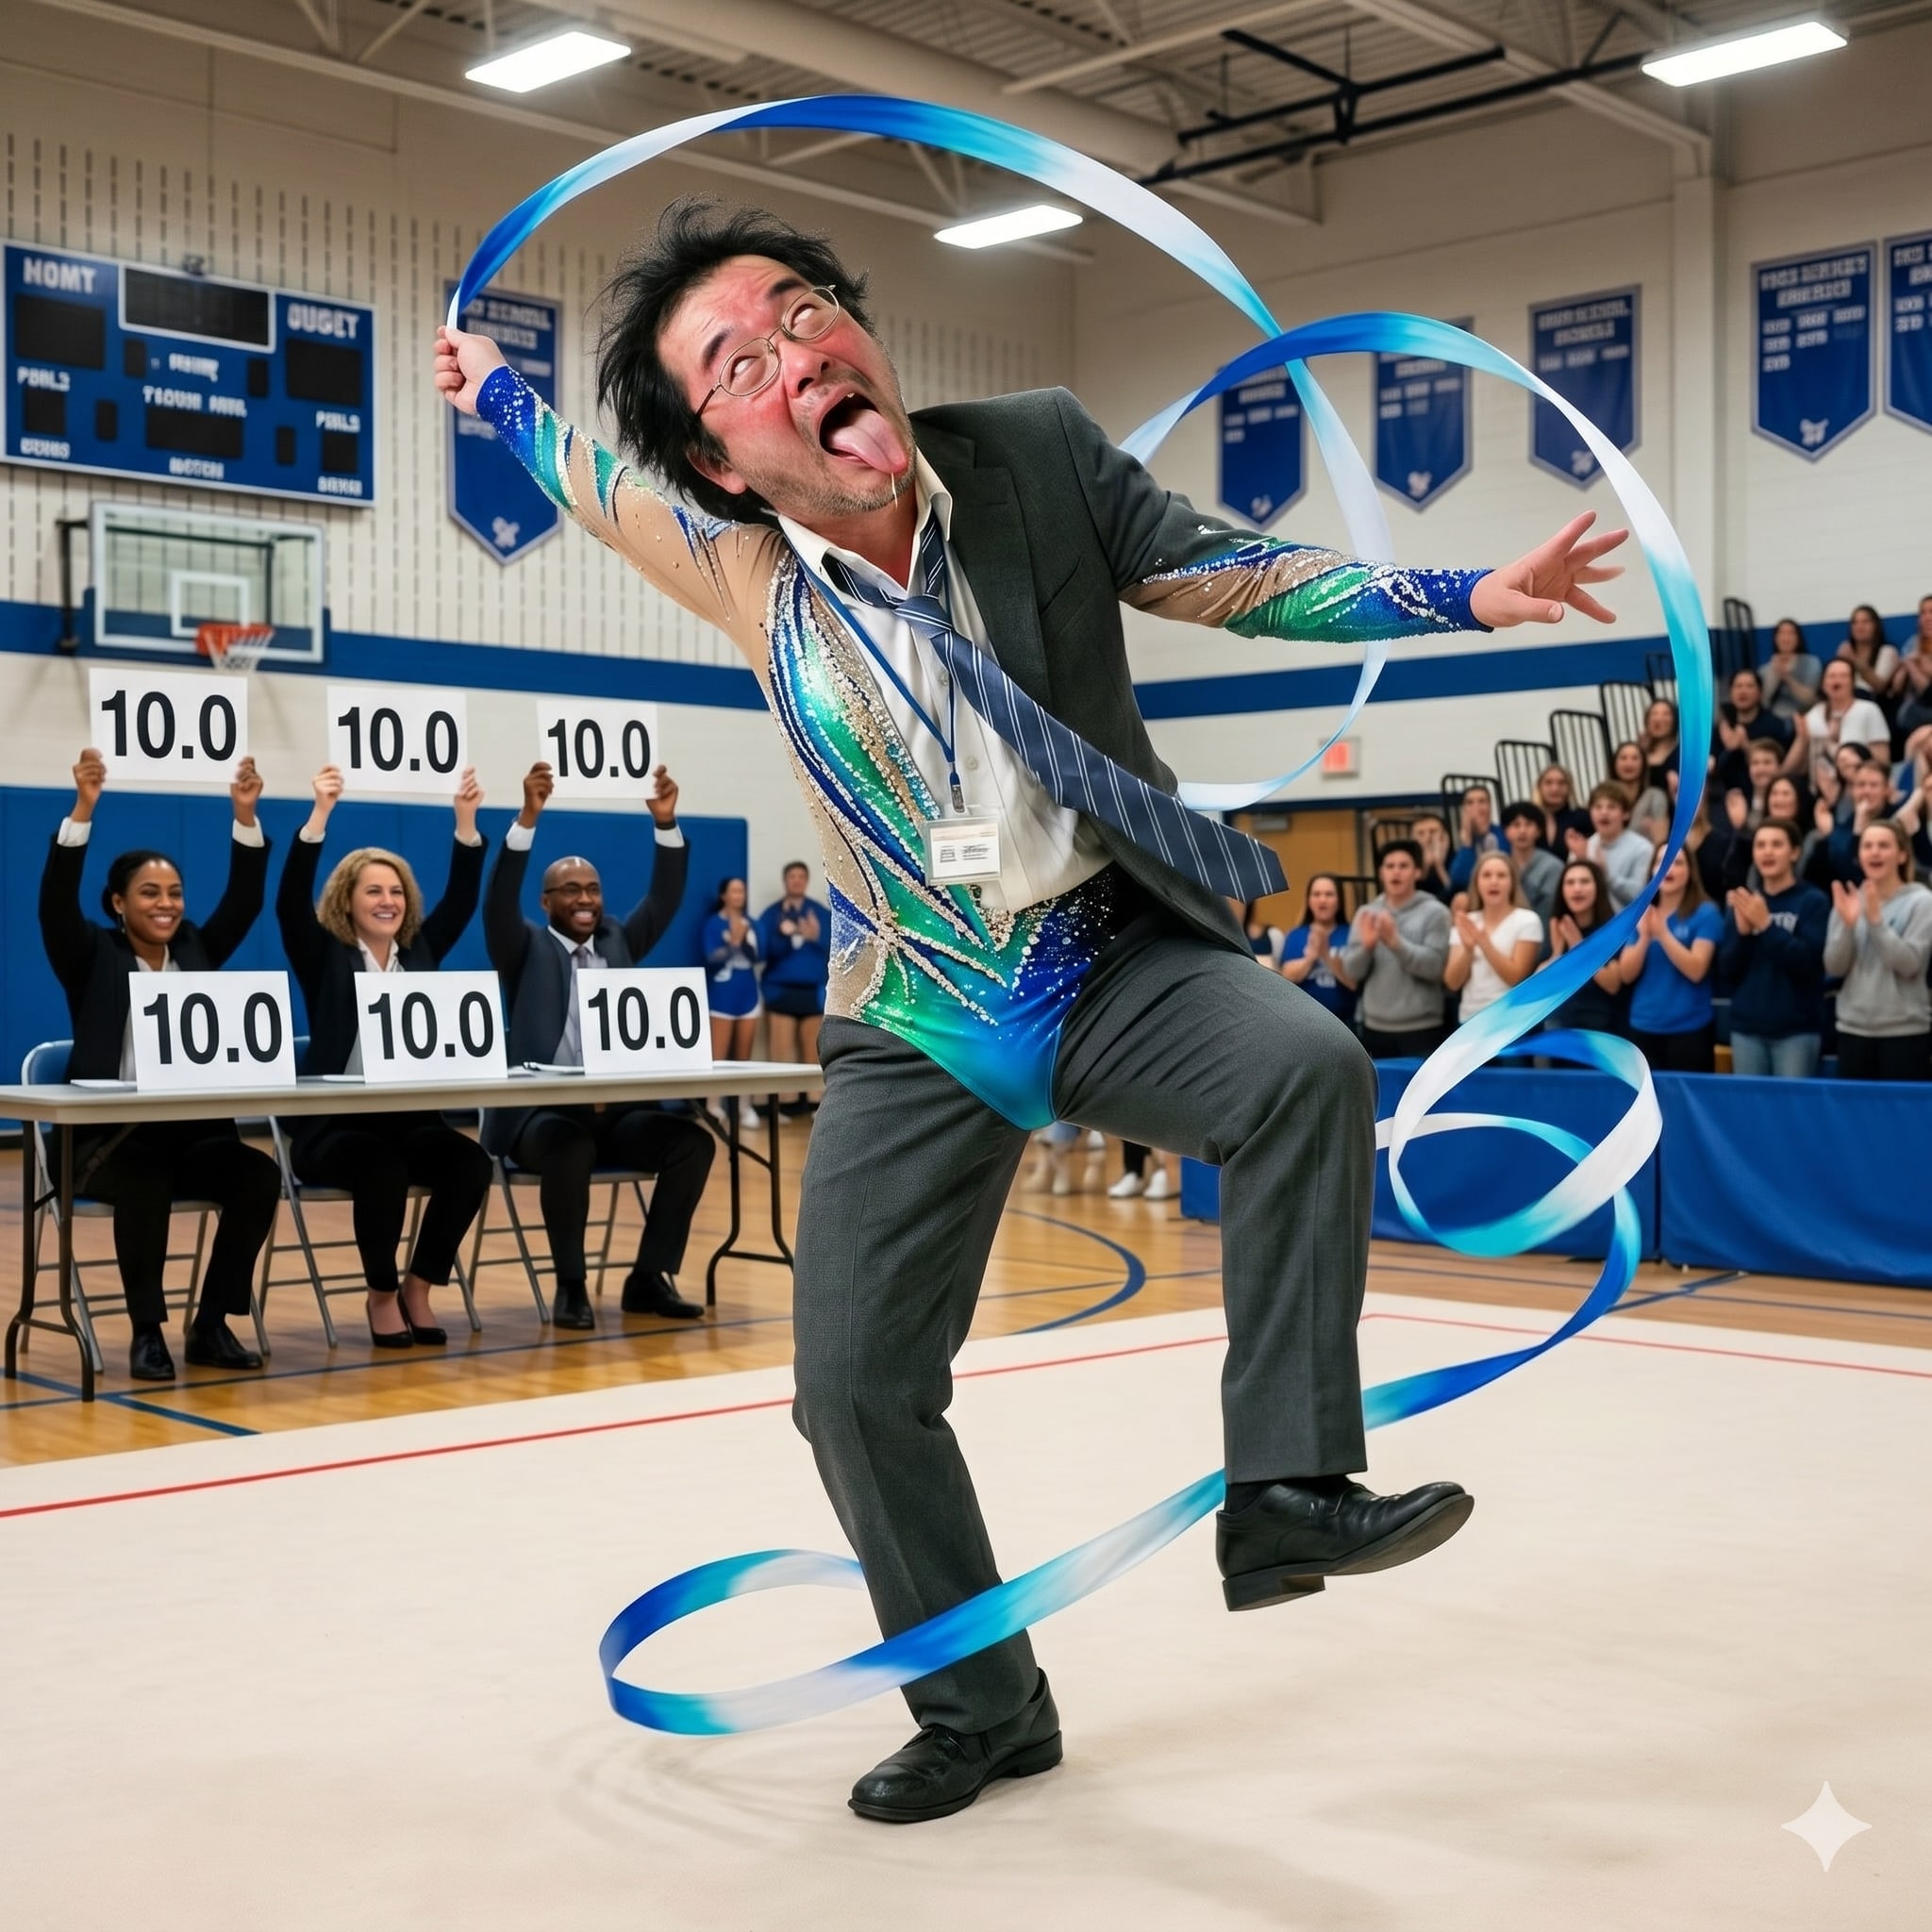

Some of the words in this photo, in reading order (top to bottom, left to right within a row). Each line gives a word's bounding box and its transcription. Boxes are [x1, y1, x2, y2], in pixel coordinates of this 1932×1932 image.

[101, 690, 237, 761] 10.0
[338, 707, 458, 774] 10.0
[547, 718, 651, 779] 10.0
[142, 991, 282, 1066] 10.0
[368, 991, 494, 1060] 10.0
[588, 986, 701, 1051] 10.0
